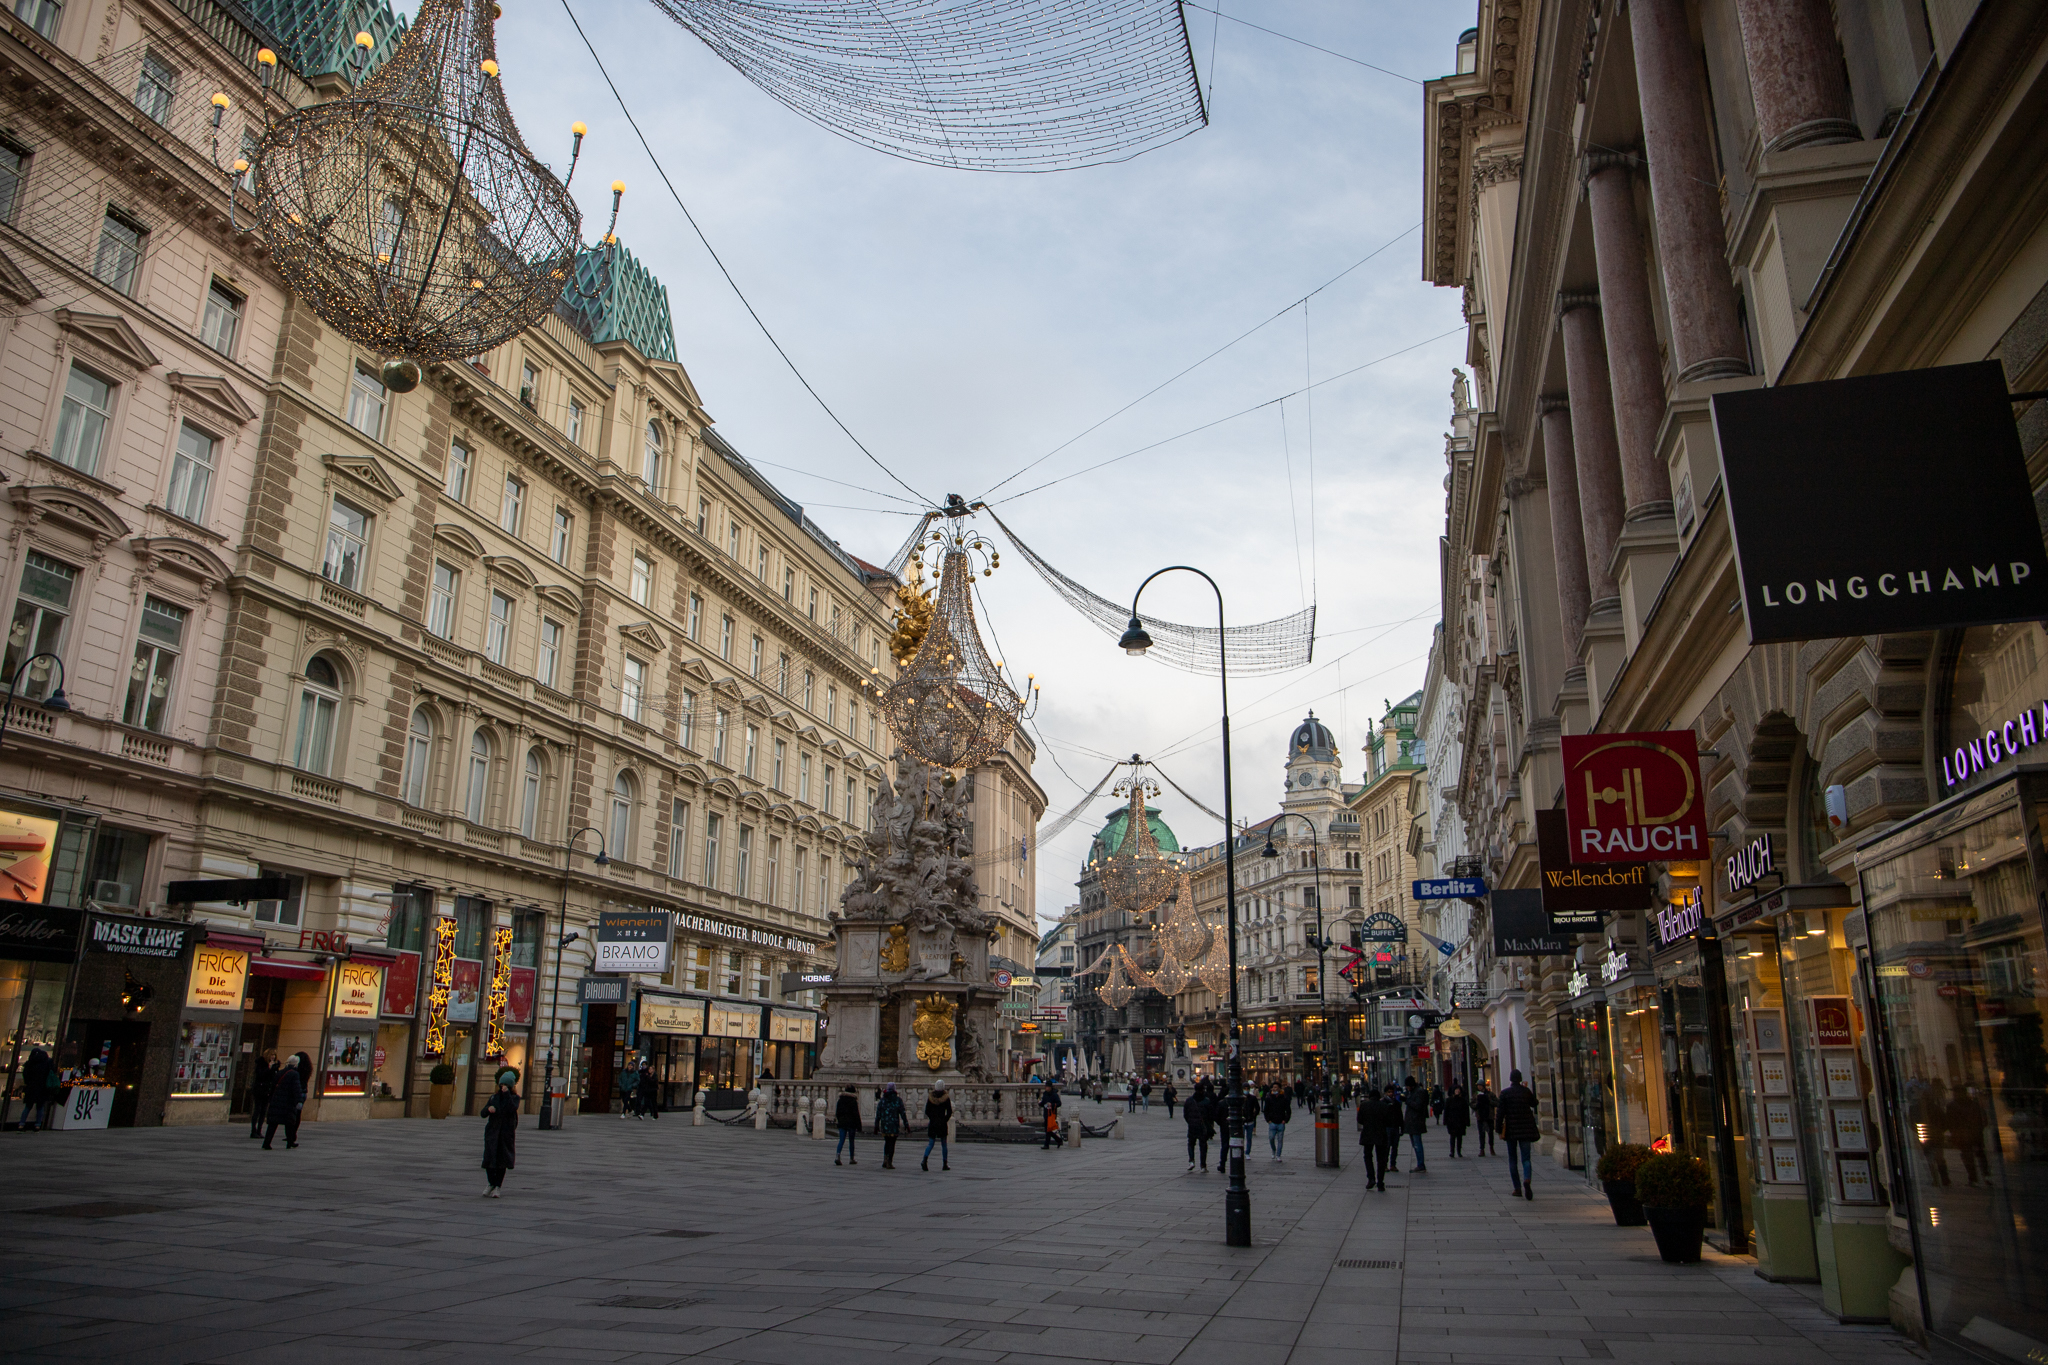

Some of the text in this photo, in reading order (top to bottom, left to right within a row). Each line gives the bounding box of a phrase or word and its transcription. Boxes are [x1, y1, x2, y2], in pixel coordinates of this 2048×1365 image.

[1762, 561, 2030, 607] LONGCHAMP
[1580, 825, 1698, 853] RAUCH
[1727, 833, 1770, 892] RAUCH
[1545, 866, 1645, 888] Wellendorff
[1420, 880, 1475, 896] Berlitz
[1657, 886, 1702, 945] Wellendorff
[93, 921, 185, 949] MASK HAVE
[106, 944, 178, 957] WWW.MASKHAVE.AT
[602, 945, 660, 959] BRAMO
[786, 936, 815, 955] HÜBNER
[1503, 938, 1562, 951] MaxMara
[209, 977, 226, 987] Die
[195, 988, 236, 997] Buchhandlung
[351, 989, 365, 998] Die
[77, 1089, 100, 1105] MA
[74, 1104, 94, 1120] SK
